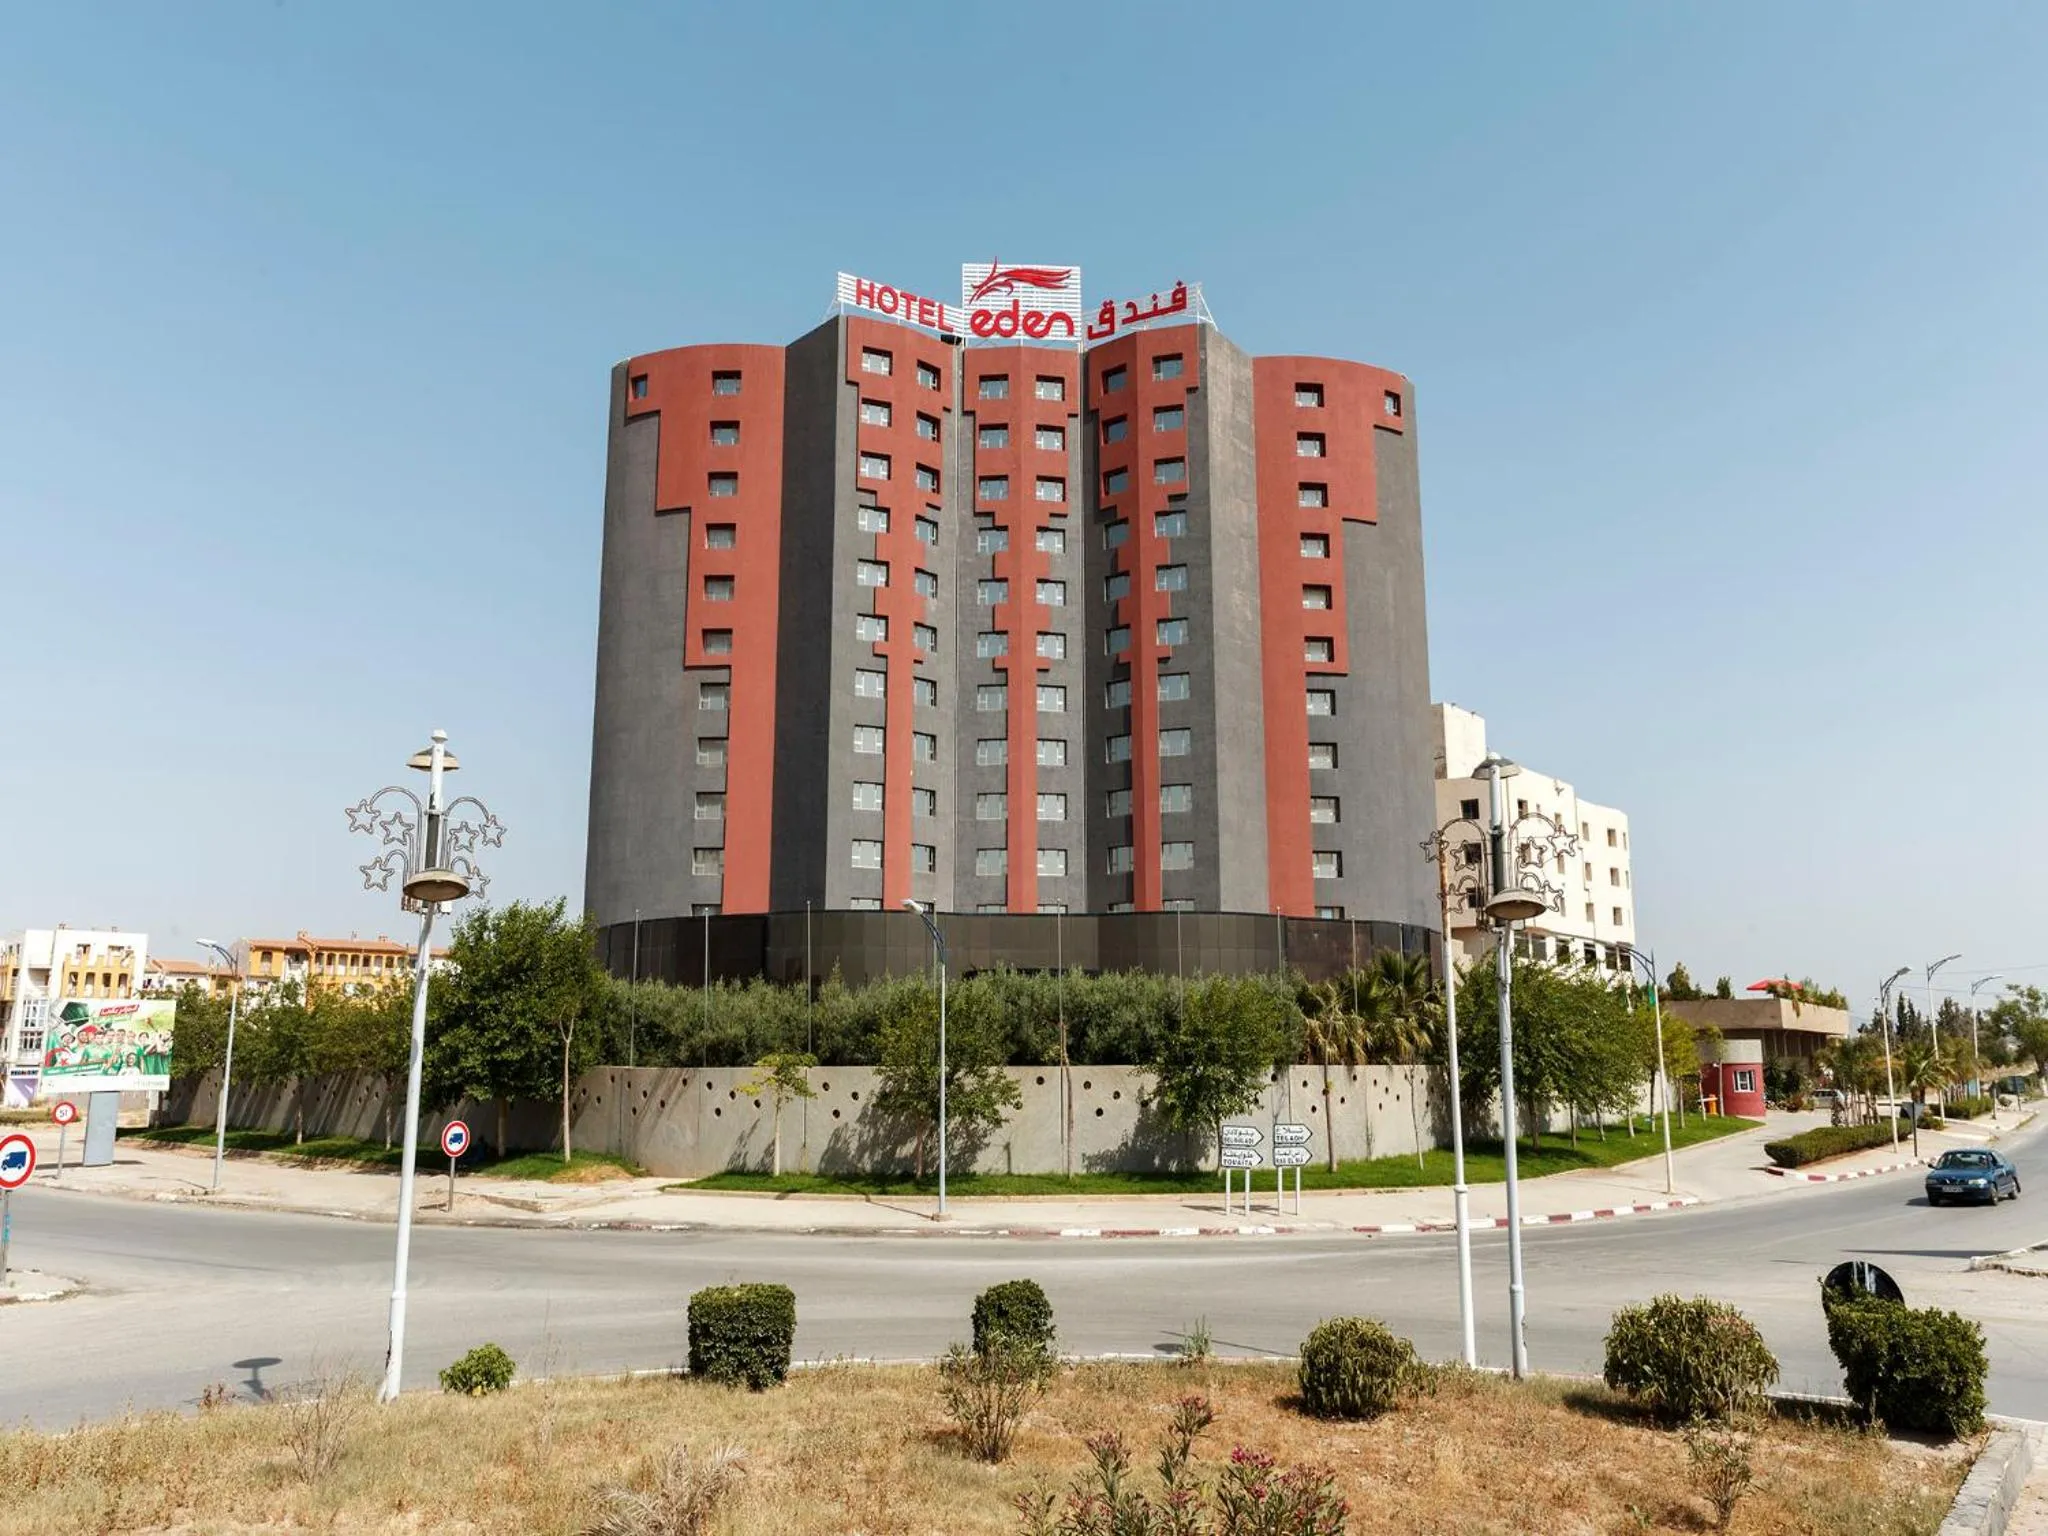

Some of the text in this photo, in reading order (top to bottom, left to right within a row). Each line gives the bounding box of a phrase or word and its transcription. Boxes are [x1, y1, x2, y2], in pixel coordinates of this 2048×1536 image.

[856, 278, 954, 332] HOTEL
[970, 299, 1075, 338] eden
[1087, 280, 1187, 340] فندق
